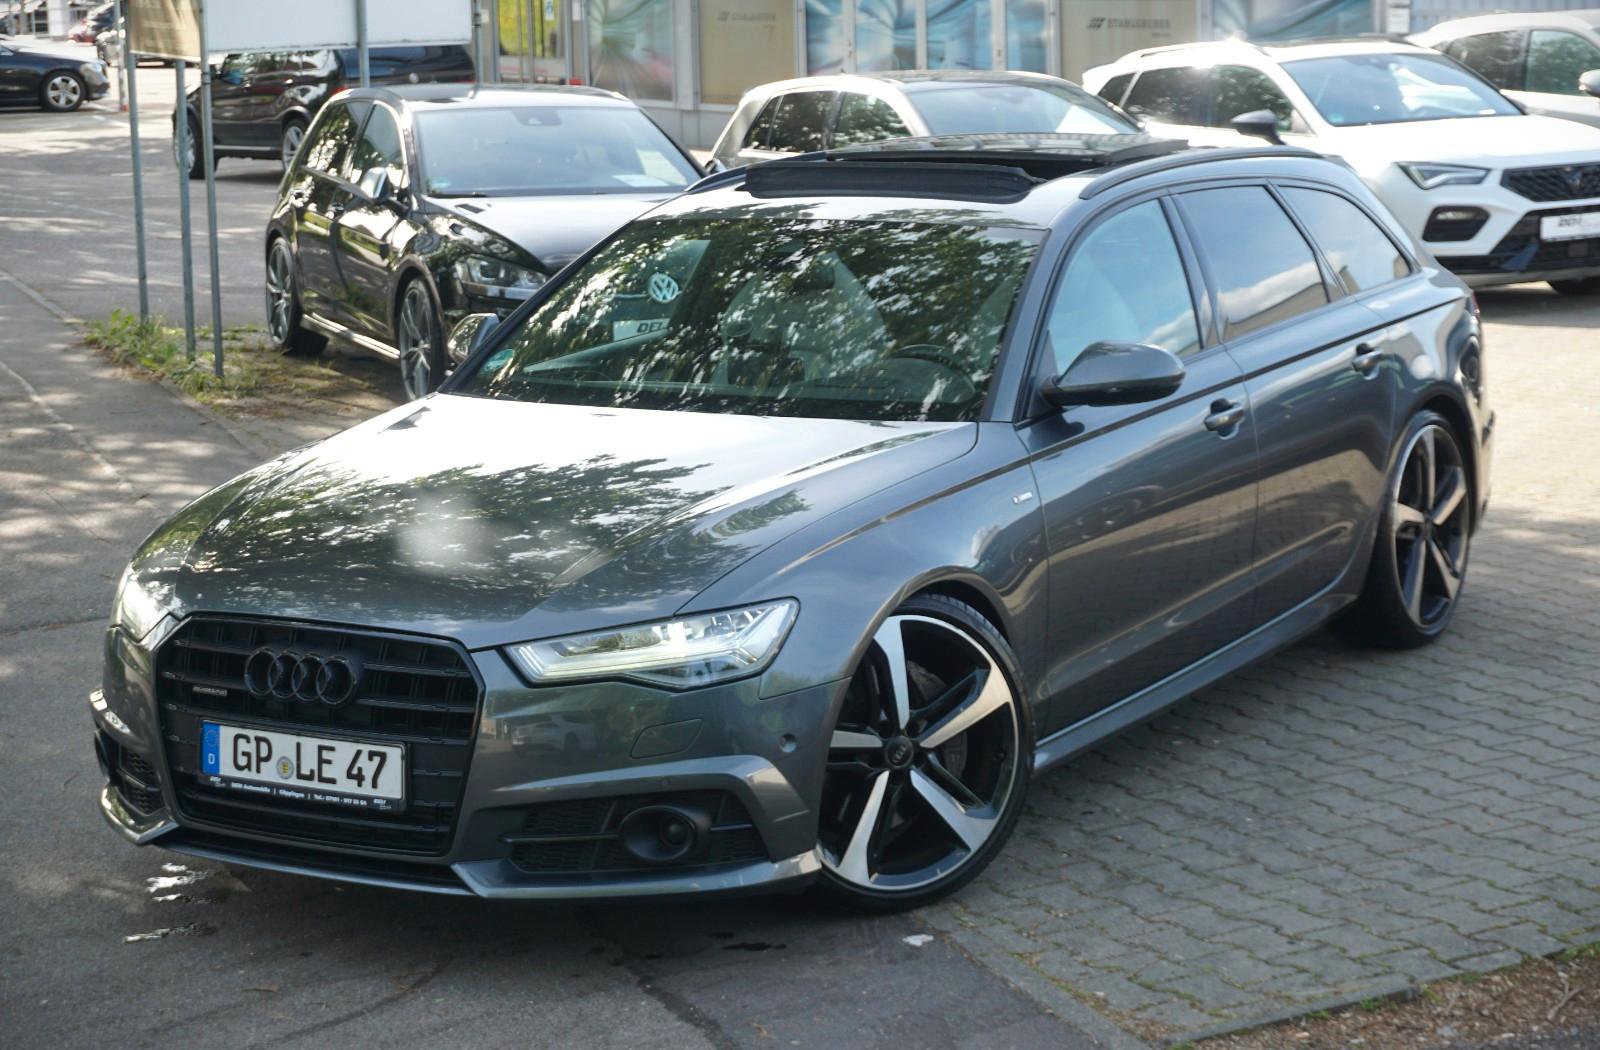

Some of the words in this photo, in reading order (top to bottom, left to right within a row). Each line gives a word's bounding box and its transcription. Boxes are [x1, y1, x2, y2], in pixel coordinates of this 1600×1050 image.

[207, 753, 216, 765] D
[232, 732, 273, 774] GP
[295, 741, 337, 785] LE
[346, 749, 388, 790] 47
